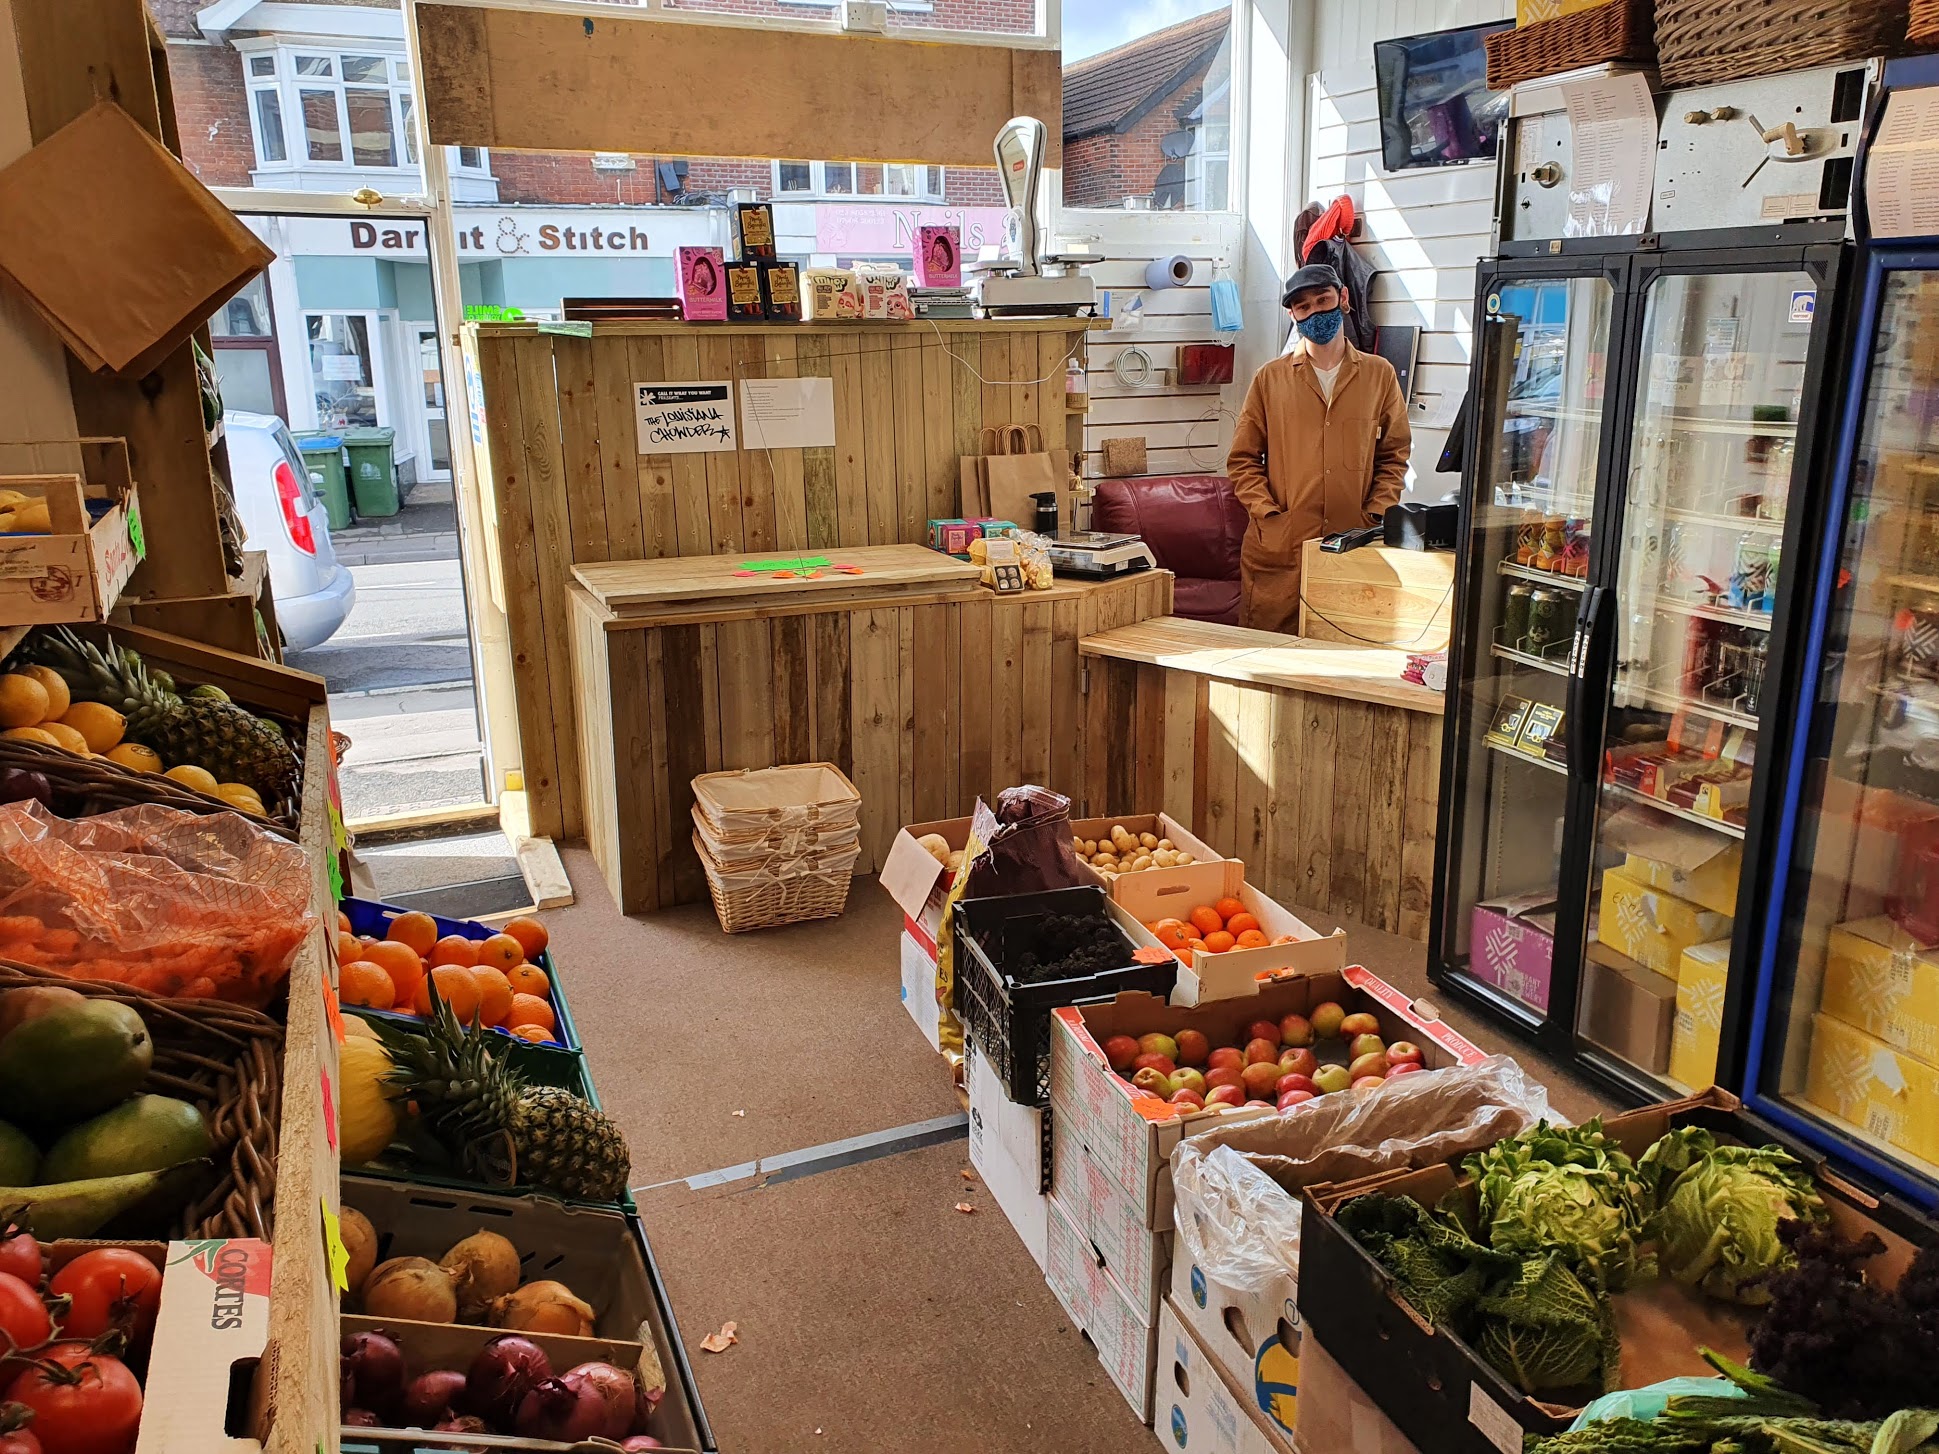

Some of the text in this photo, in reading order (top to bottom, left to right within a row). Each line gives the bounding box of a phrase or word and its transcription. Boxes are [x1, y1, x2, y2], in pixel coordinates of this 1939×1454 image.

[350, 221, 420, 250] Dar
[538, 224, 649, 251] Stitch
[893, 210, 985, 249] Nls
[644, 407, 724, 427] THE LOUISIANA
[650, 423, 714, 443] CHOWDER
[1364, 978, 1396, 1000] QUALITY
[1440, 1032, 1478, 1058] PRODUCE
[211, 1248, 249, 1329] CORTES
